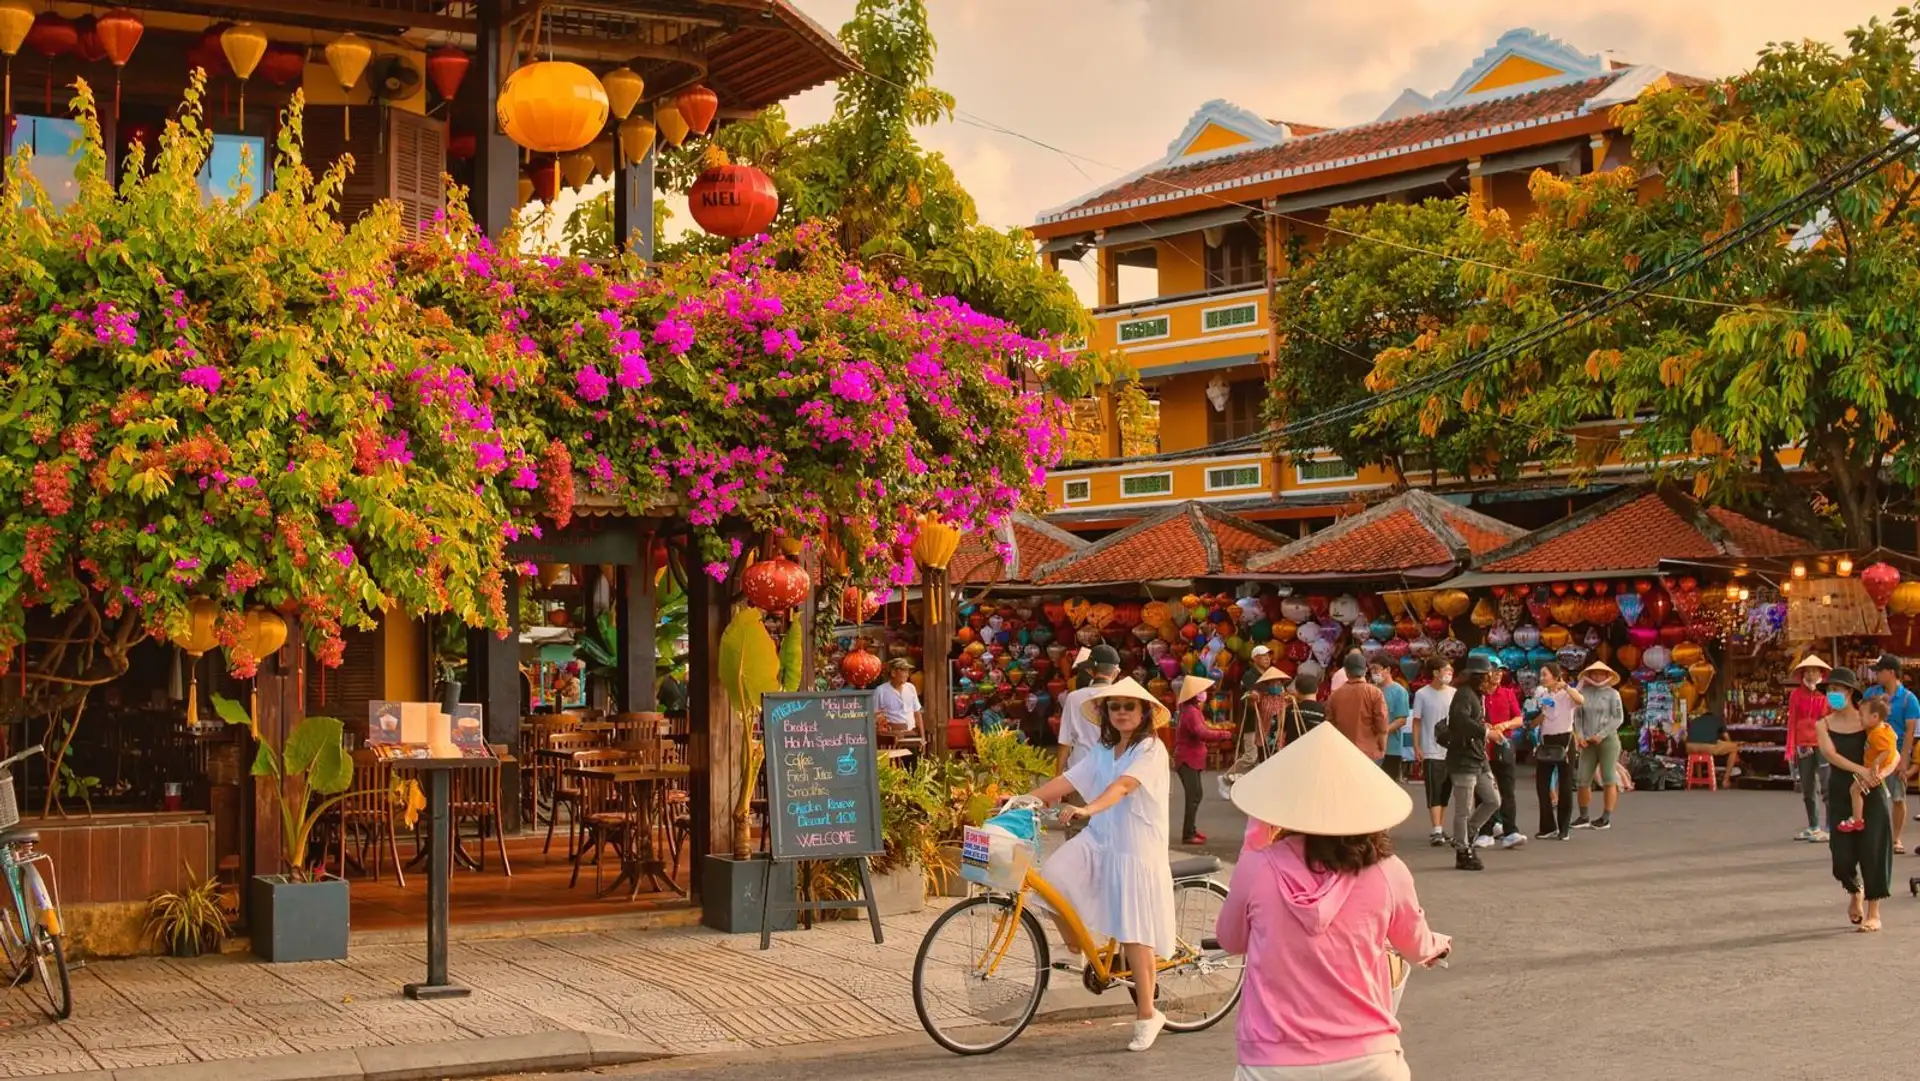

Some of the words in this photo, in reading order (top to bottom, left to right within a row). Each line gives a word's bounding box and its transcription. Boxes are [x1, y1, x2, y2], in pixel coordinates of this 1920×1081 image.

[702, 191, 741, 207] KIEU
[784, 752, 815, 770] Coffee
[796, 830, 858, 848] WELCOME
